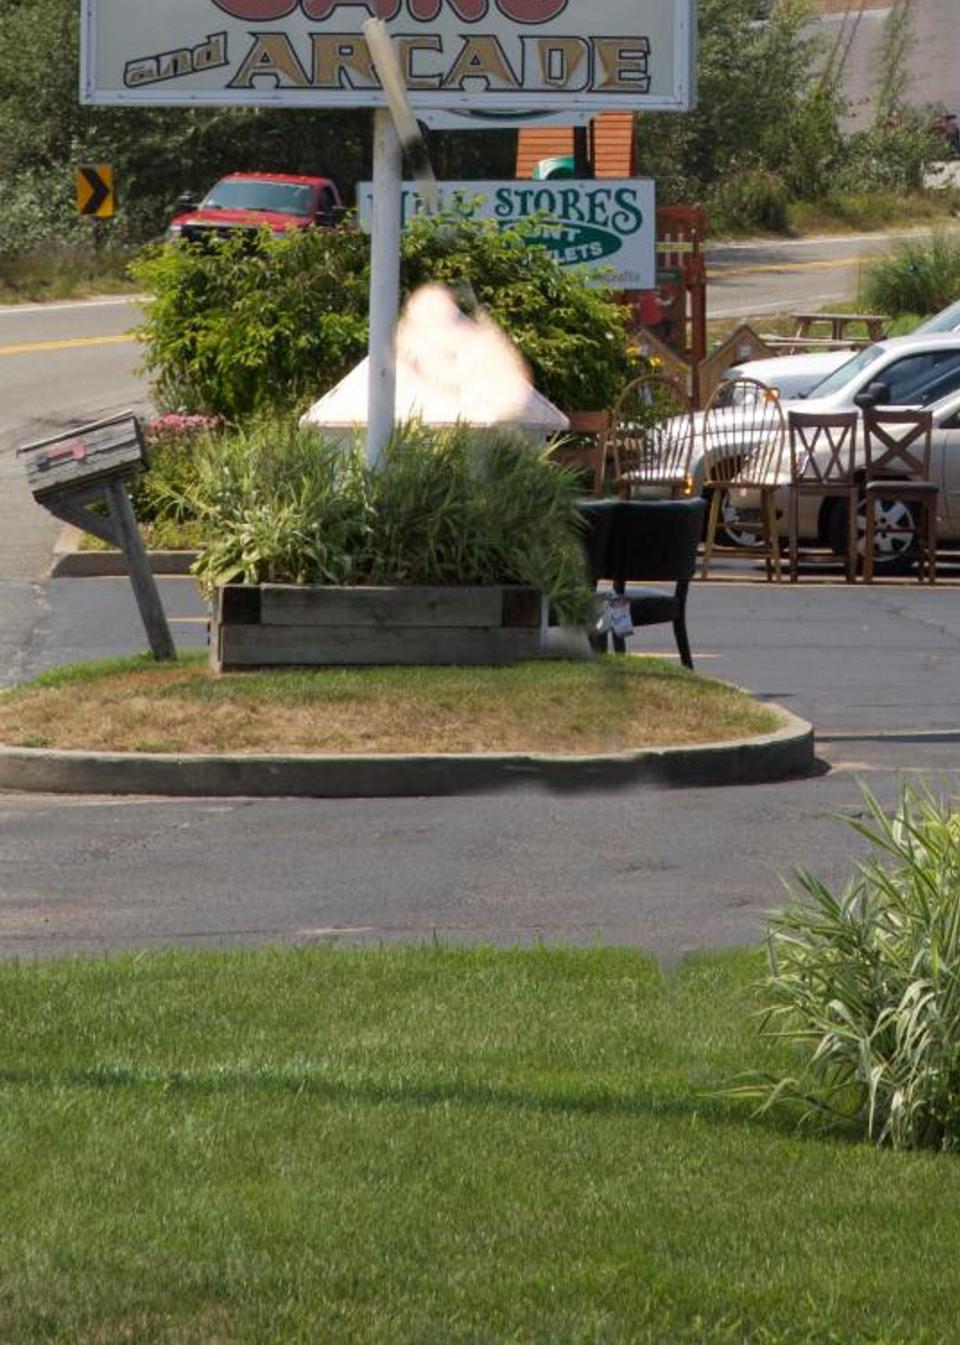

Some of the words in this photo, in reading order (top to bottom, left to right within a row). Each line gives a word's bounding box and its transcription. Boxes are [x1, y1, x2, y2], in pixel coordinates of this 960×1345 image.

[123, 30, 229, 88] and
[226, 32, 651, 94] ARCADE
[494, 187, 643, 235] STORES
